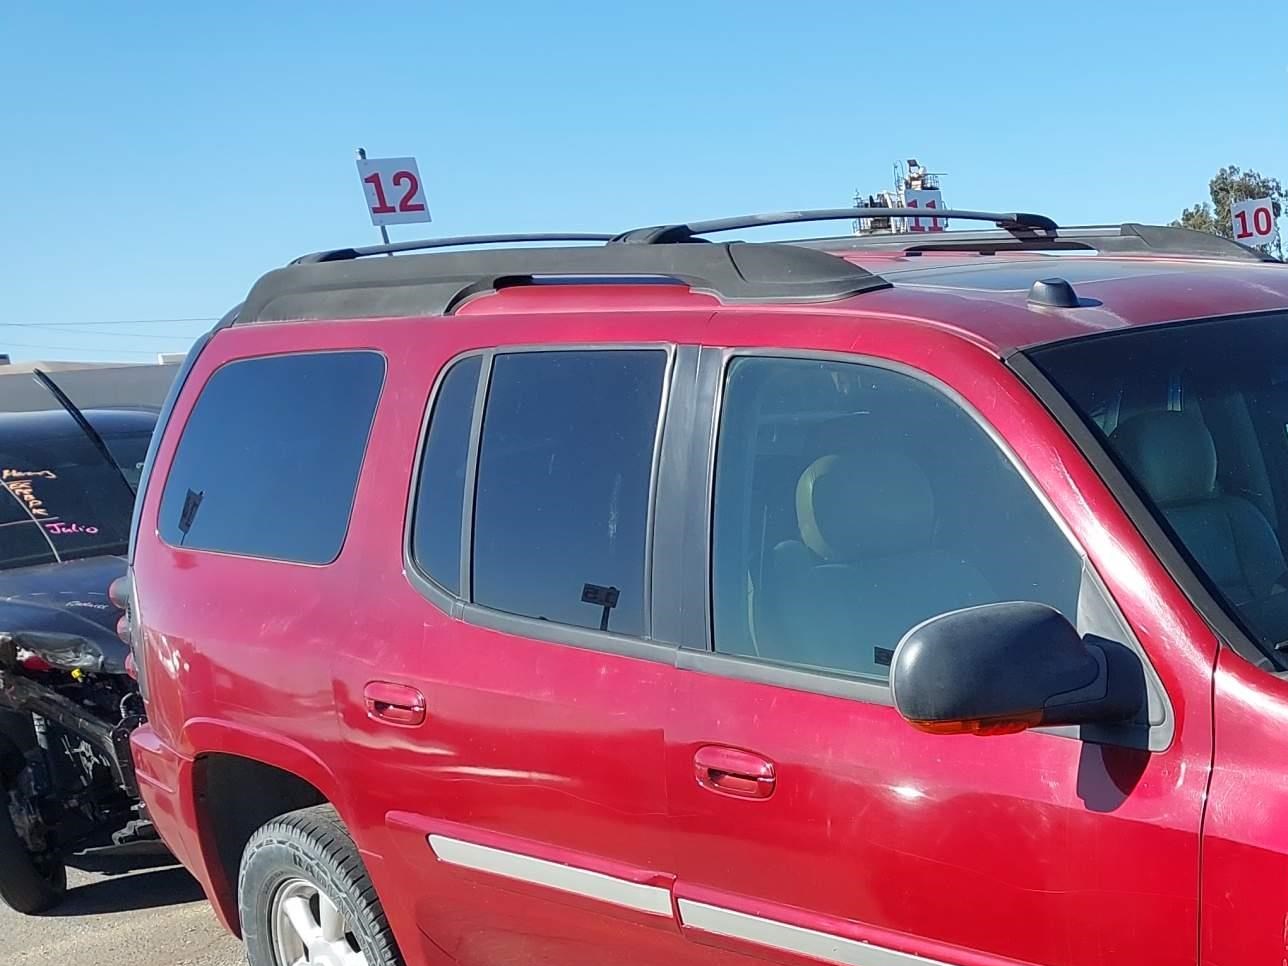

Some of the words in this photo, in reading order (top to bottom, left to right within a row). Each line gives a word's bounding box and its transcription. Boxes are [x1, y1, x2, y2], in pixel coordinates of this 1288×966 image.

[364, 171, 425, 214] 12
[907, 199, 943, 232] 11
[1235, 207, 1272, 239] 10
[45, 523, 98, 534] Julio
